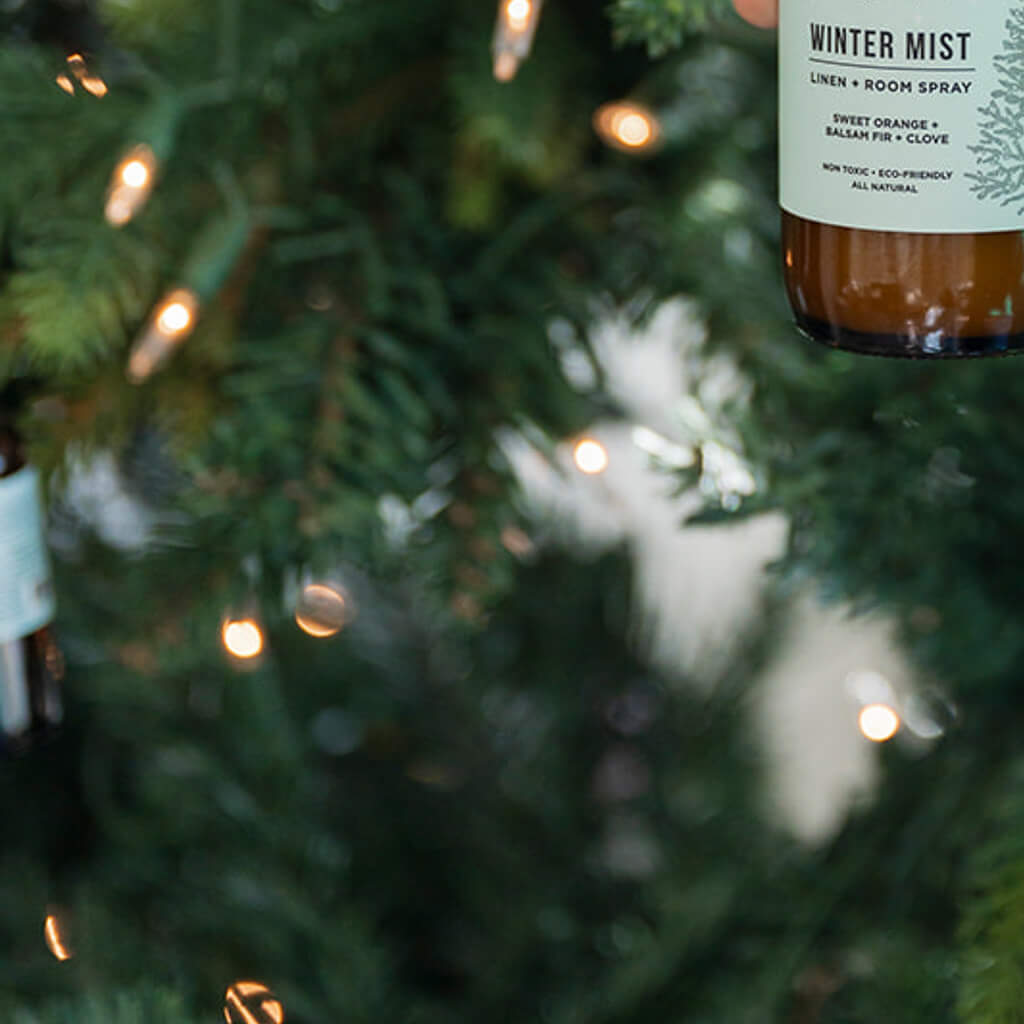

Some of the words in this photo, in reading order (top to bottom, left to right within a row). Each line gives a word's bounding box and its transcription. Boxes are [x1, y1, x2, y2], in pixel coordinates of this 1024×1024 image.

[809, 21, 894, 60] WINTER
[905, 31, 972, 62] MIST
[810, 71, 847, 88] LINEN
[864, 78, 913, 94] ROOM
[918, 81, 973, 95] SPRAY
[832, 112, 871, 127] SWEET
[873, 117, 928, 131] ORANGE
[825, 125, 870, 141] BALSAM
[871, 131, 893, 143] FIR
[905, 133, 949, 145] CLOVE
[822, 161, 841, 173] NON
[842, 164, 870, 177] TOXIC
[878, 167, 953, 181] ECO-FRIENDLY
[851, 180, 869, 191] ALL
[870, 182, 918, 194] NATURAL
